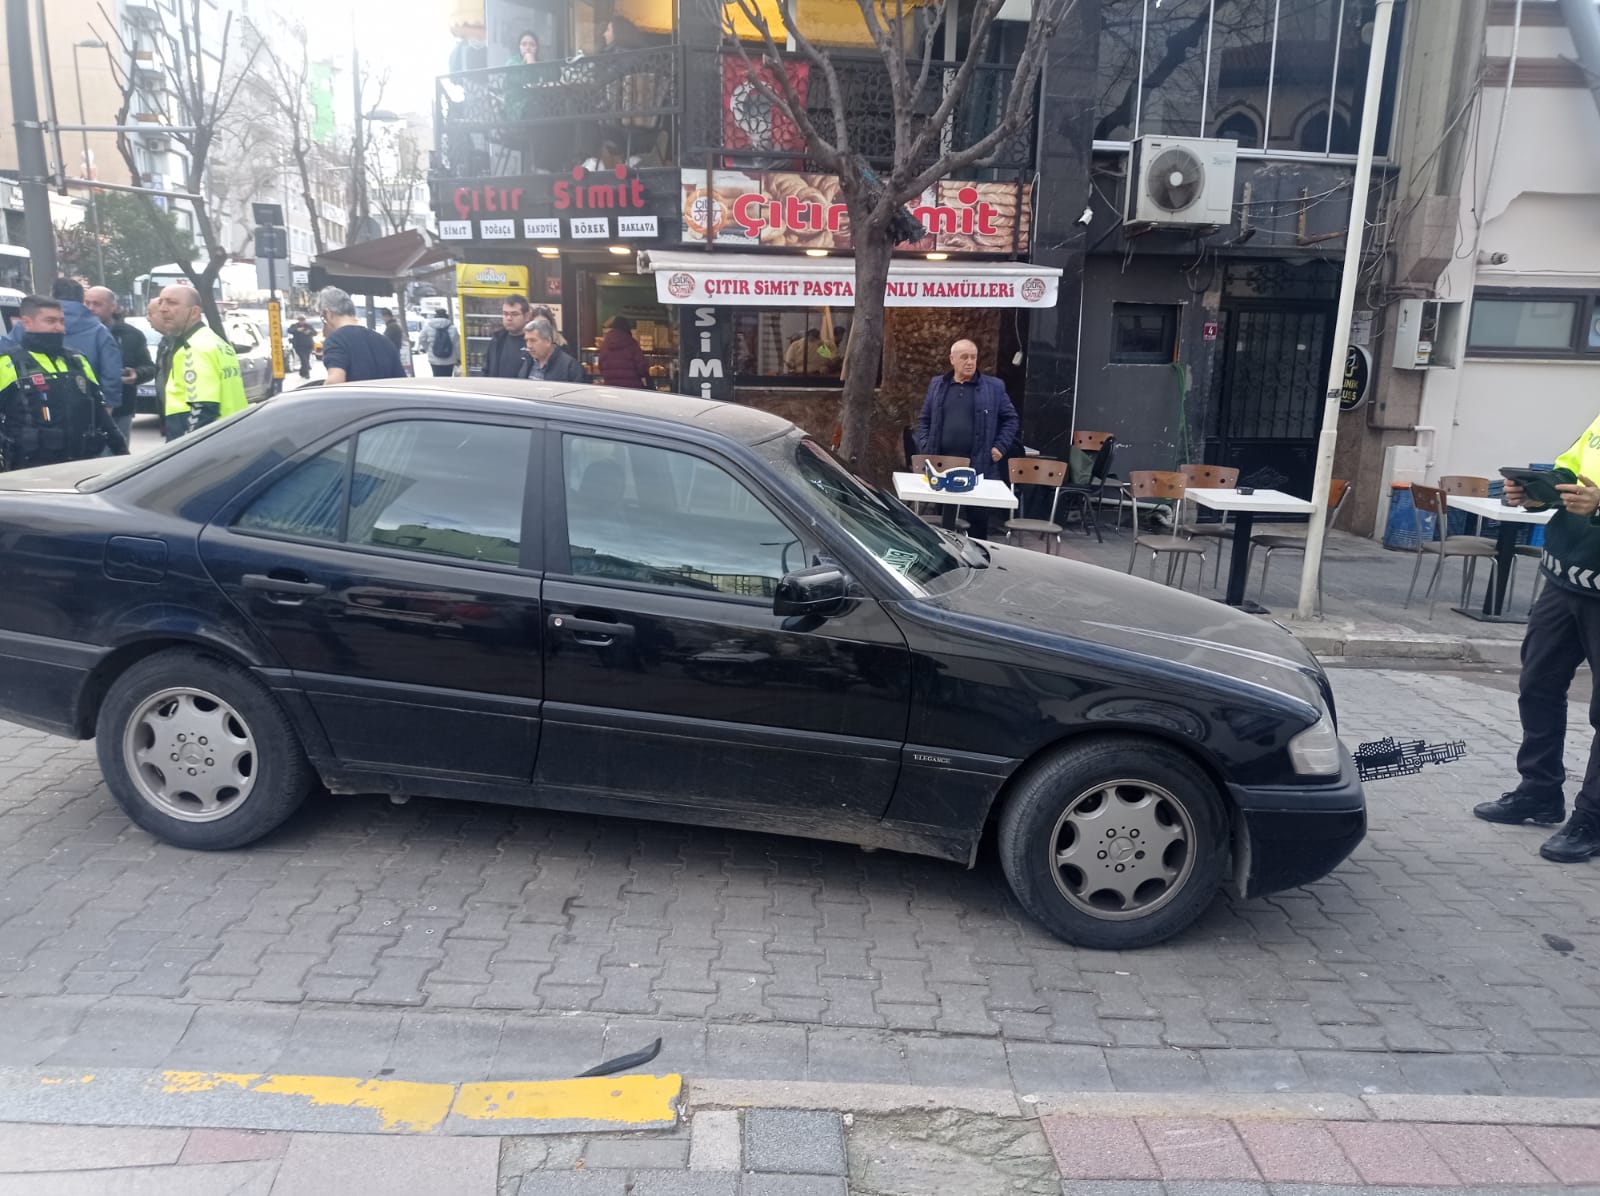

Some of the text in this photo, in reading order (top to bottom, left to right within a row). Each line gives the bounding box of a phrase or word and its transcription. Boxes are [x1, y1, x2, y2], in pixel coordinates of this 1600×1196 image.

[554, 165, 645, 209] Simit
[912, 187, 998, 235] mit
[575, 222, 606, 234] BÖREK
[621, 223, 655, 232] BAKLAVA
[704, 279, 750, 298] ÇITIR
[803, 281, 853, 296] PASTA
[886, 282, 919, 297] NLU
[689, 307, 723, 399] SiMi
